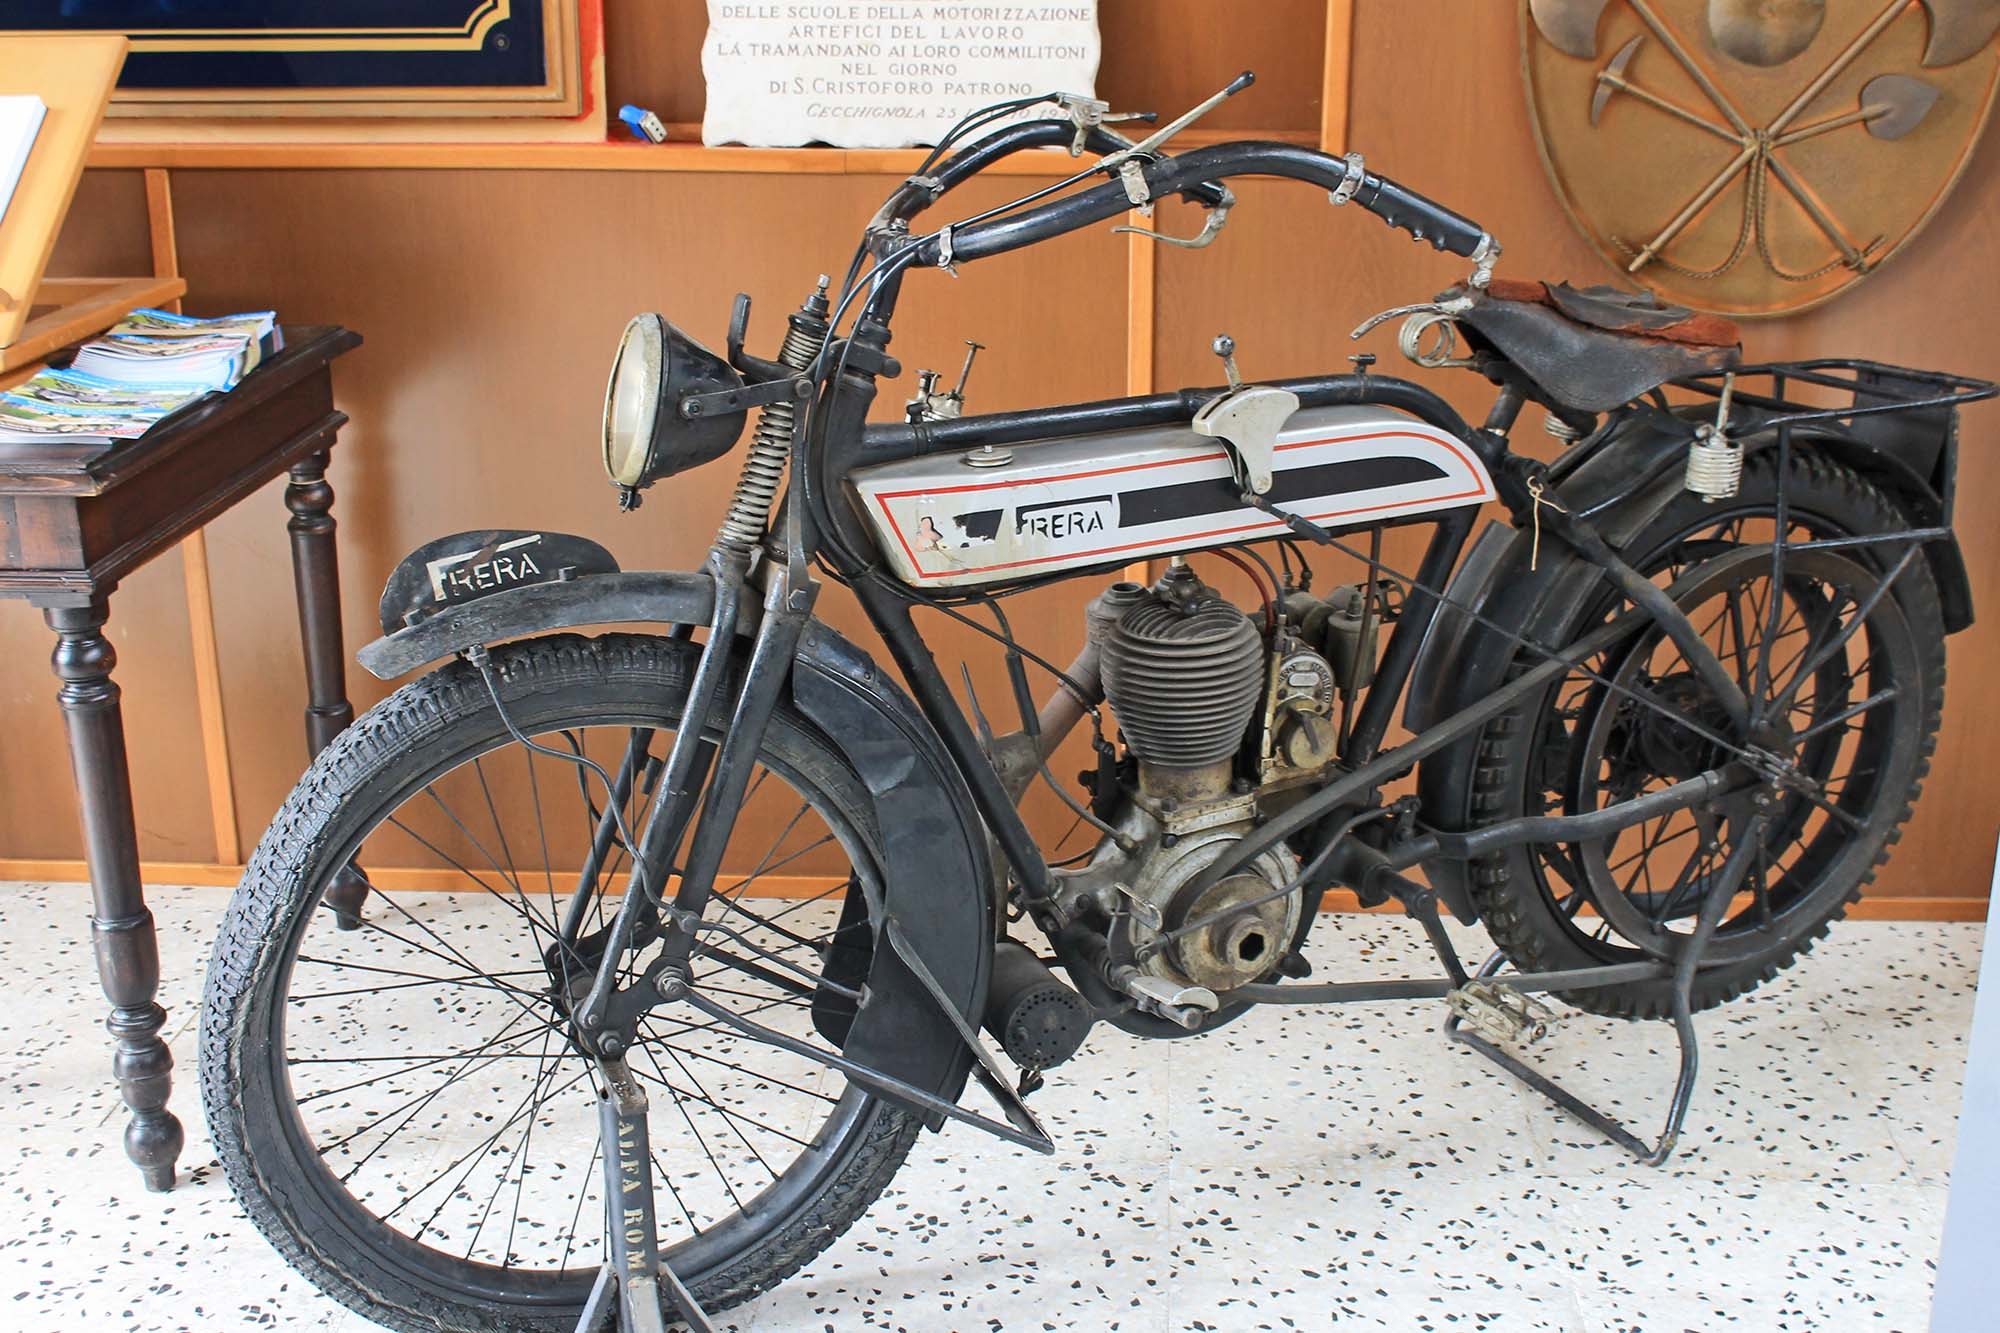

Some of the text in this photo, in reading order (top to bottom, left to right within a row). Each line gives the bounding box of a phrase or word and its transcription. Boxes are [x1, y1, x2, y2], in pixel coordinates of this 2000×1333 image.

[722, 6, 1091, 21] DELLE SCUOLE DELLA MOTORIZZAZIONE
[788, 25, 1024, 39] ARTEFICI DEL LAVORO
[749, 43, 881, 57] TRAMANDANO
[888, 46, 909, 58] AI
[913, 46, 960, 58] LORO
[968, 46, 1086, 60] COMMILITONI
[841, 63, 957, 76] NEL GIORNO
[769, 81, 787, 94] DI
[945, 83, 1032, 95] PATRONO
[936, 107, 956, 119] 25
[1015, 494, 1113, 539] FRERA
[426, 534, 541, 602] FRERA
[617, 1120, 642, 1194] ALFA
